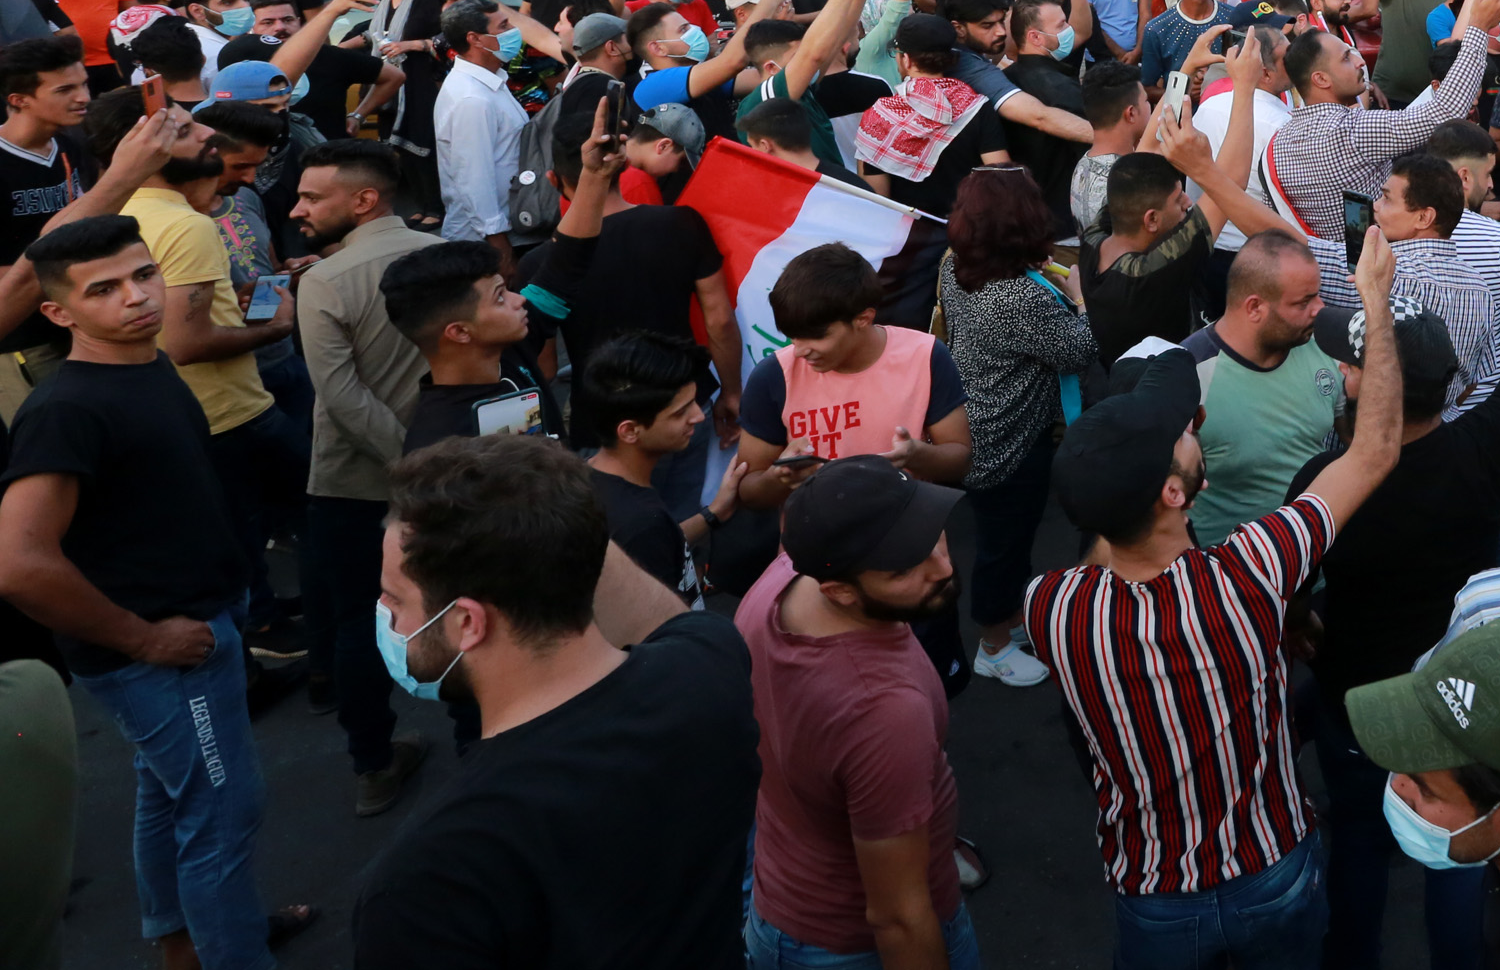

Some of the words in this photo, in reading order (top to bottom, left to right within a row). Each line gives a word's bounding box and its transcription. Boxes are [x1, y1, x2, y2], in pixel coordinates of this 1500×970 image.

[789, 400, 861, 439] GIVE
[188, 695, 216, 745] LEGENDS
[1436, 680, 1470, 730] adidas
